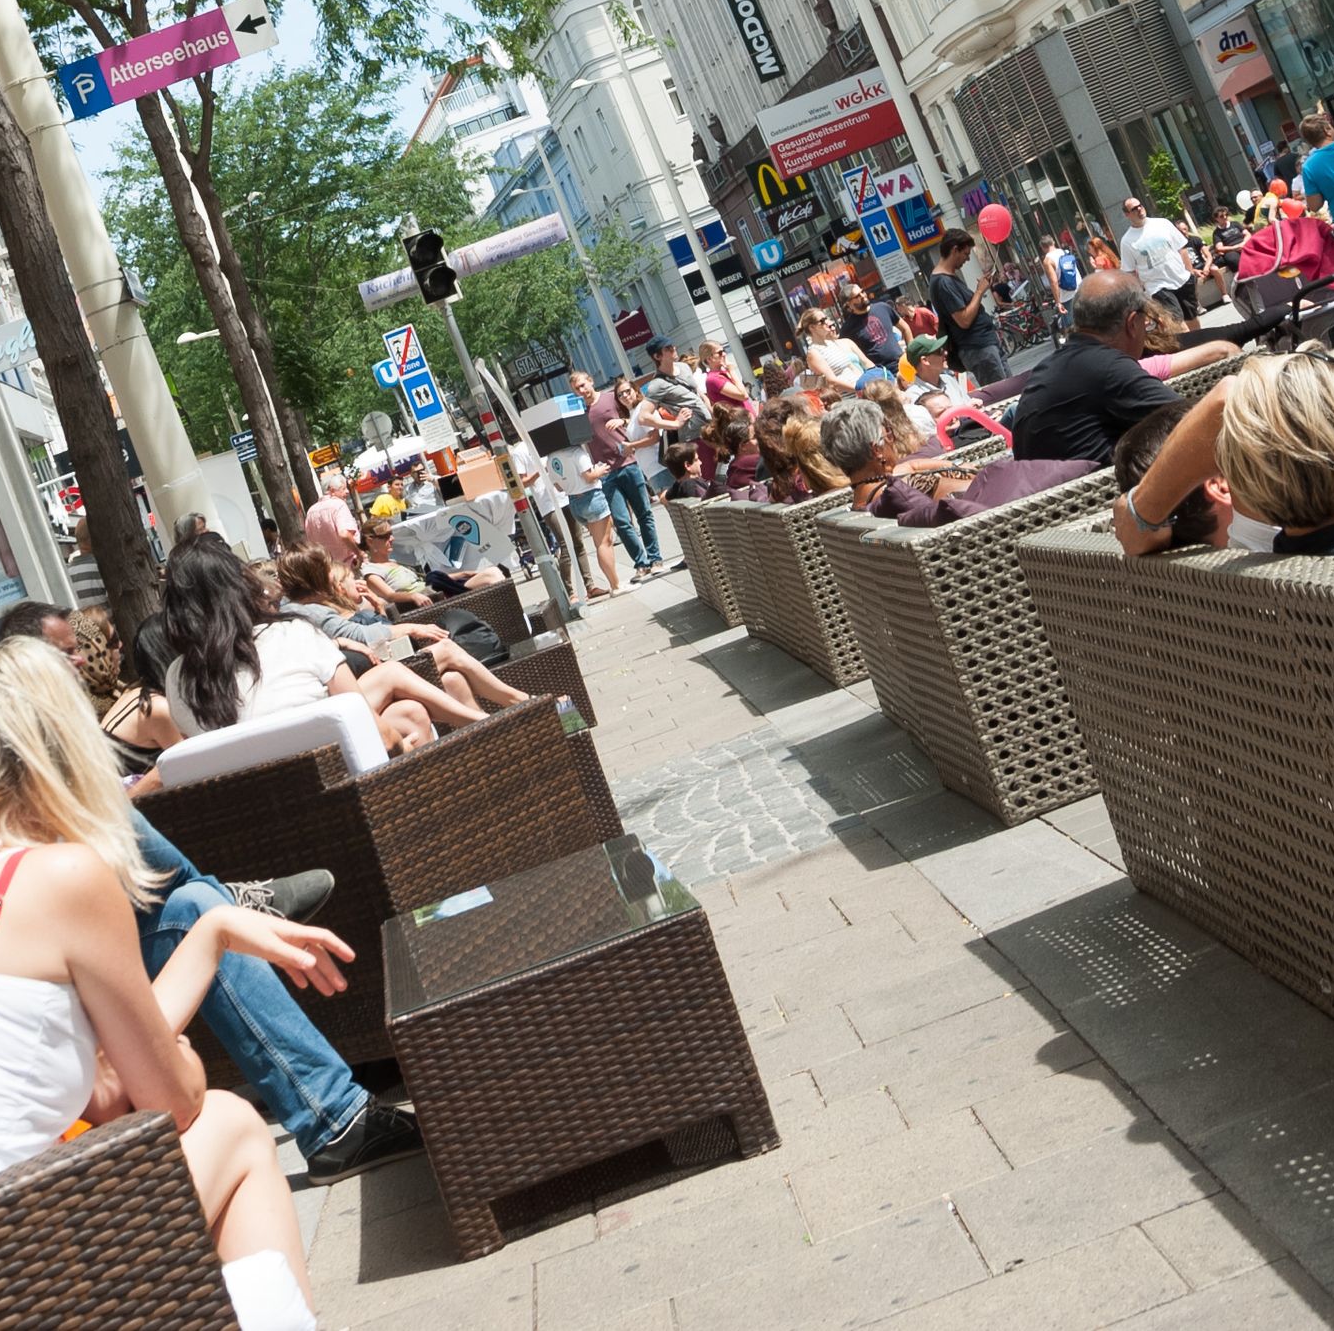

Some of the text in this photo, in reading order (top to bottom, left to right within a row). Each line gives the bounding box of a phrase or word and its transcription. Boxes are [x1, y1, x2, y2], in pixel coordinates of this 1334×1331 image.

[1219, 29, 1248, 52] dm
[110, 30, 230, 88] Atterseehaus
[808, 104, 829, 116] Wiener
[777, 112, 871, 154] Gesundheitszentrum
[779, 138, 822, 160] Wien-Mariahilf
[783, 139, 848, 170] Kundencenter
[786, 159, 813, 175] Mariahilf
[777, 200, 814, 228] McCafé
[907, 222, 936, 242] Hofer
[485, 239, 509, 253] Design
[761, 244, 780, 264] U
[782, 258, 812, 276] WEBER
[717, 271, 743, 288] WEBER
[1, 580, 20, 593] Wien
